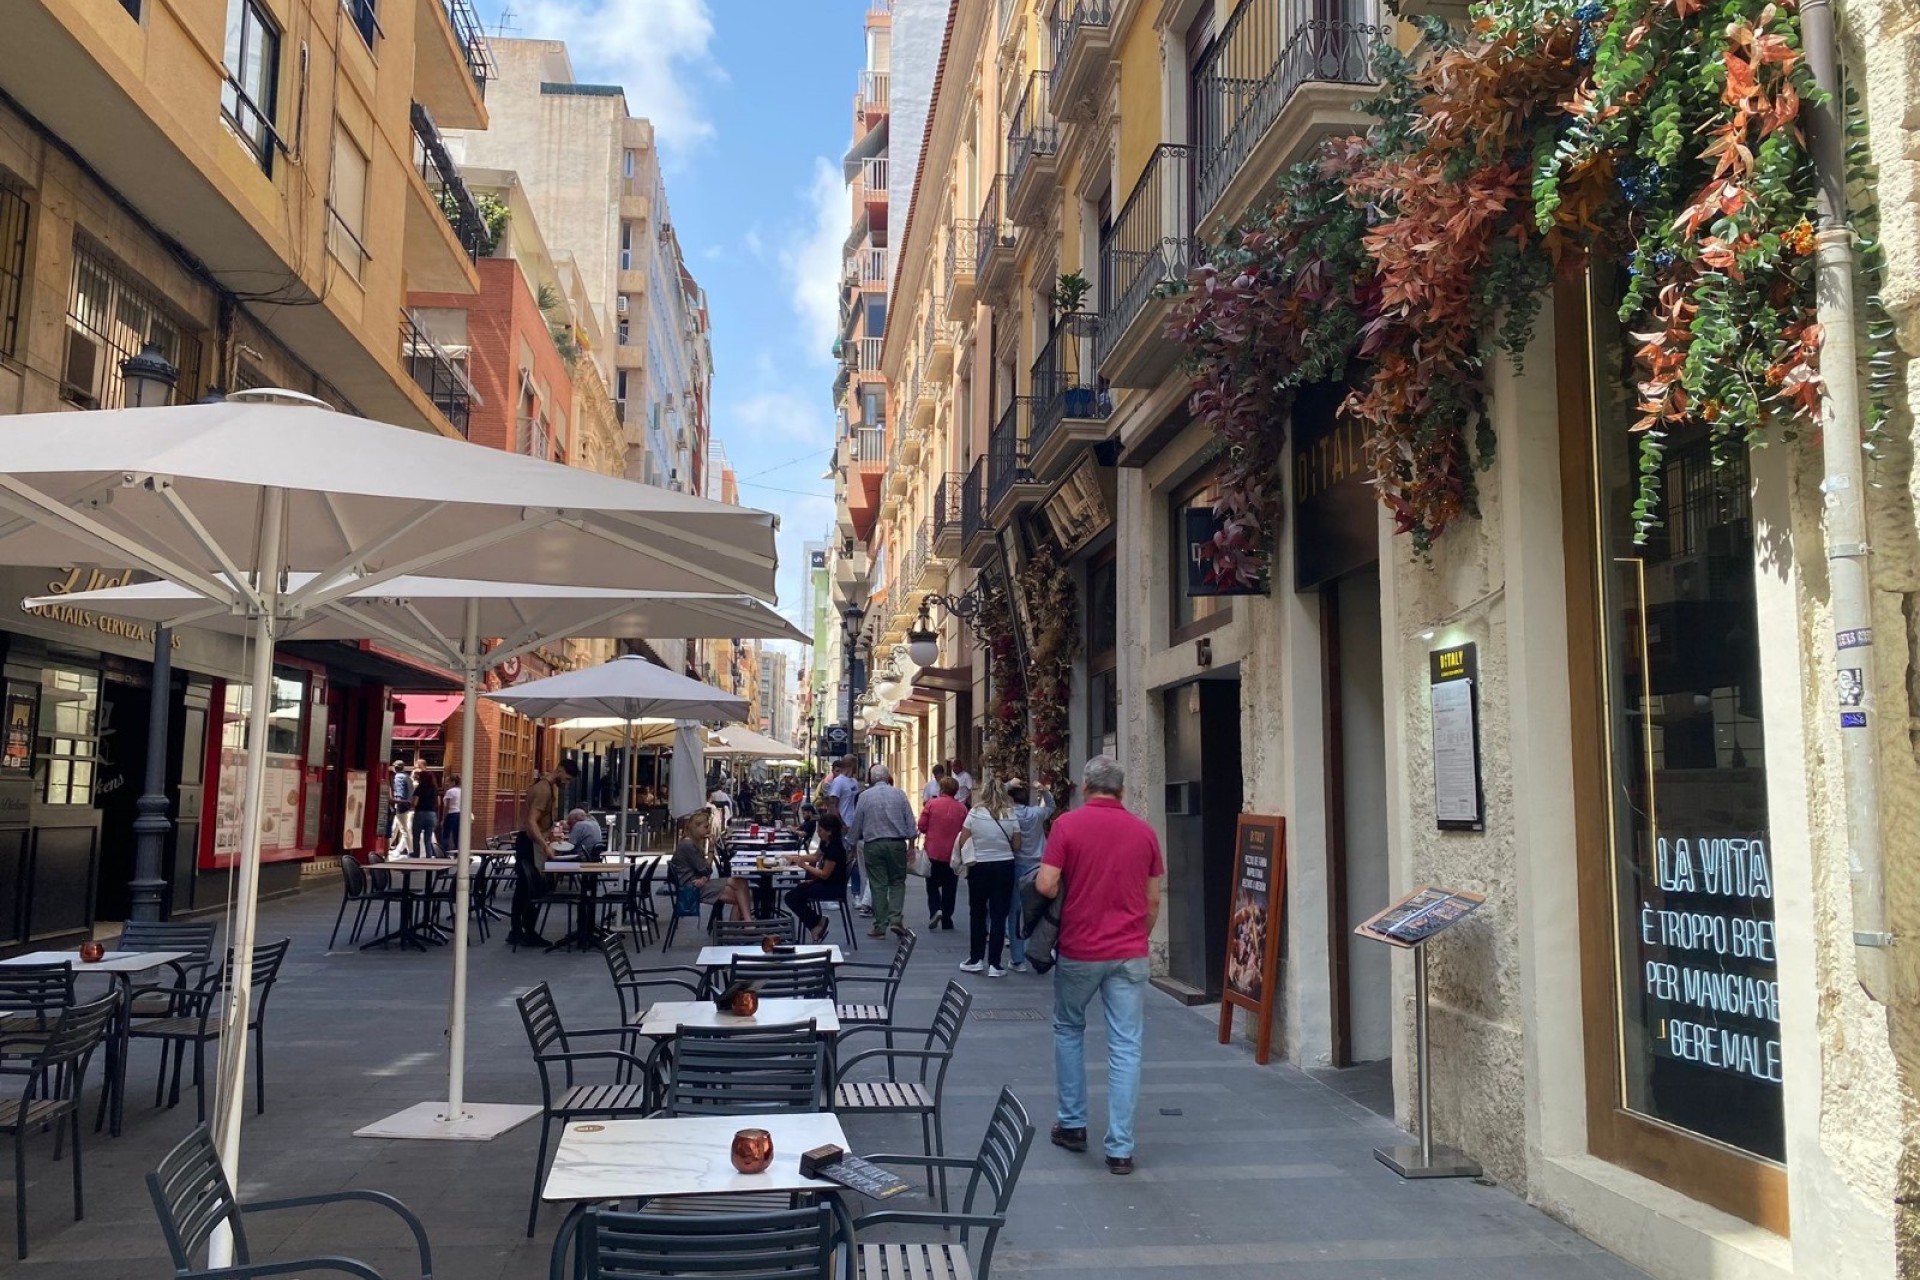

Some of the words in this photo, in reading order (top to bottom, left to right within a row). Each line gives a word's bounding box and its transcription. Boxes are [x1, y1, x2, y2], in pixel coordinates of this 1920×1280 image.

[99, 615, 144, 641] CERVEZA
[1657, 837, 1695, 892] LA
[1699, 837, 1771, 898] VITA
[1657, 910, 1727, 954] TROPPO
[1646, 961, 1679, 1002] PER
[1683, 967, 1781, 1023] MANGIARE
[1670, 1018, 1720, 1067] BERE
[1721, 1029, 1782, 1082] MALE
